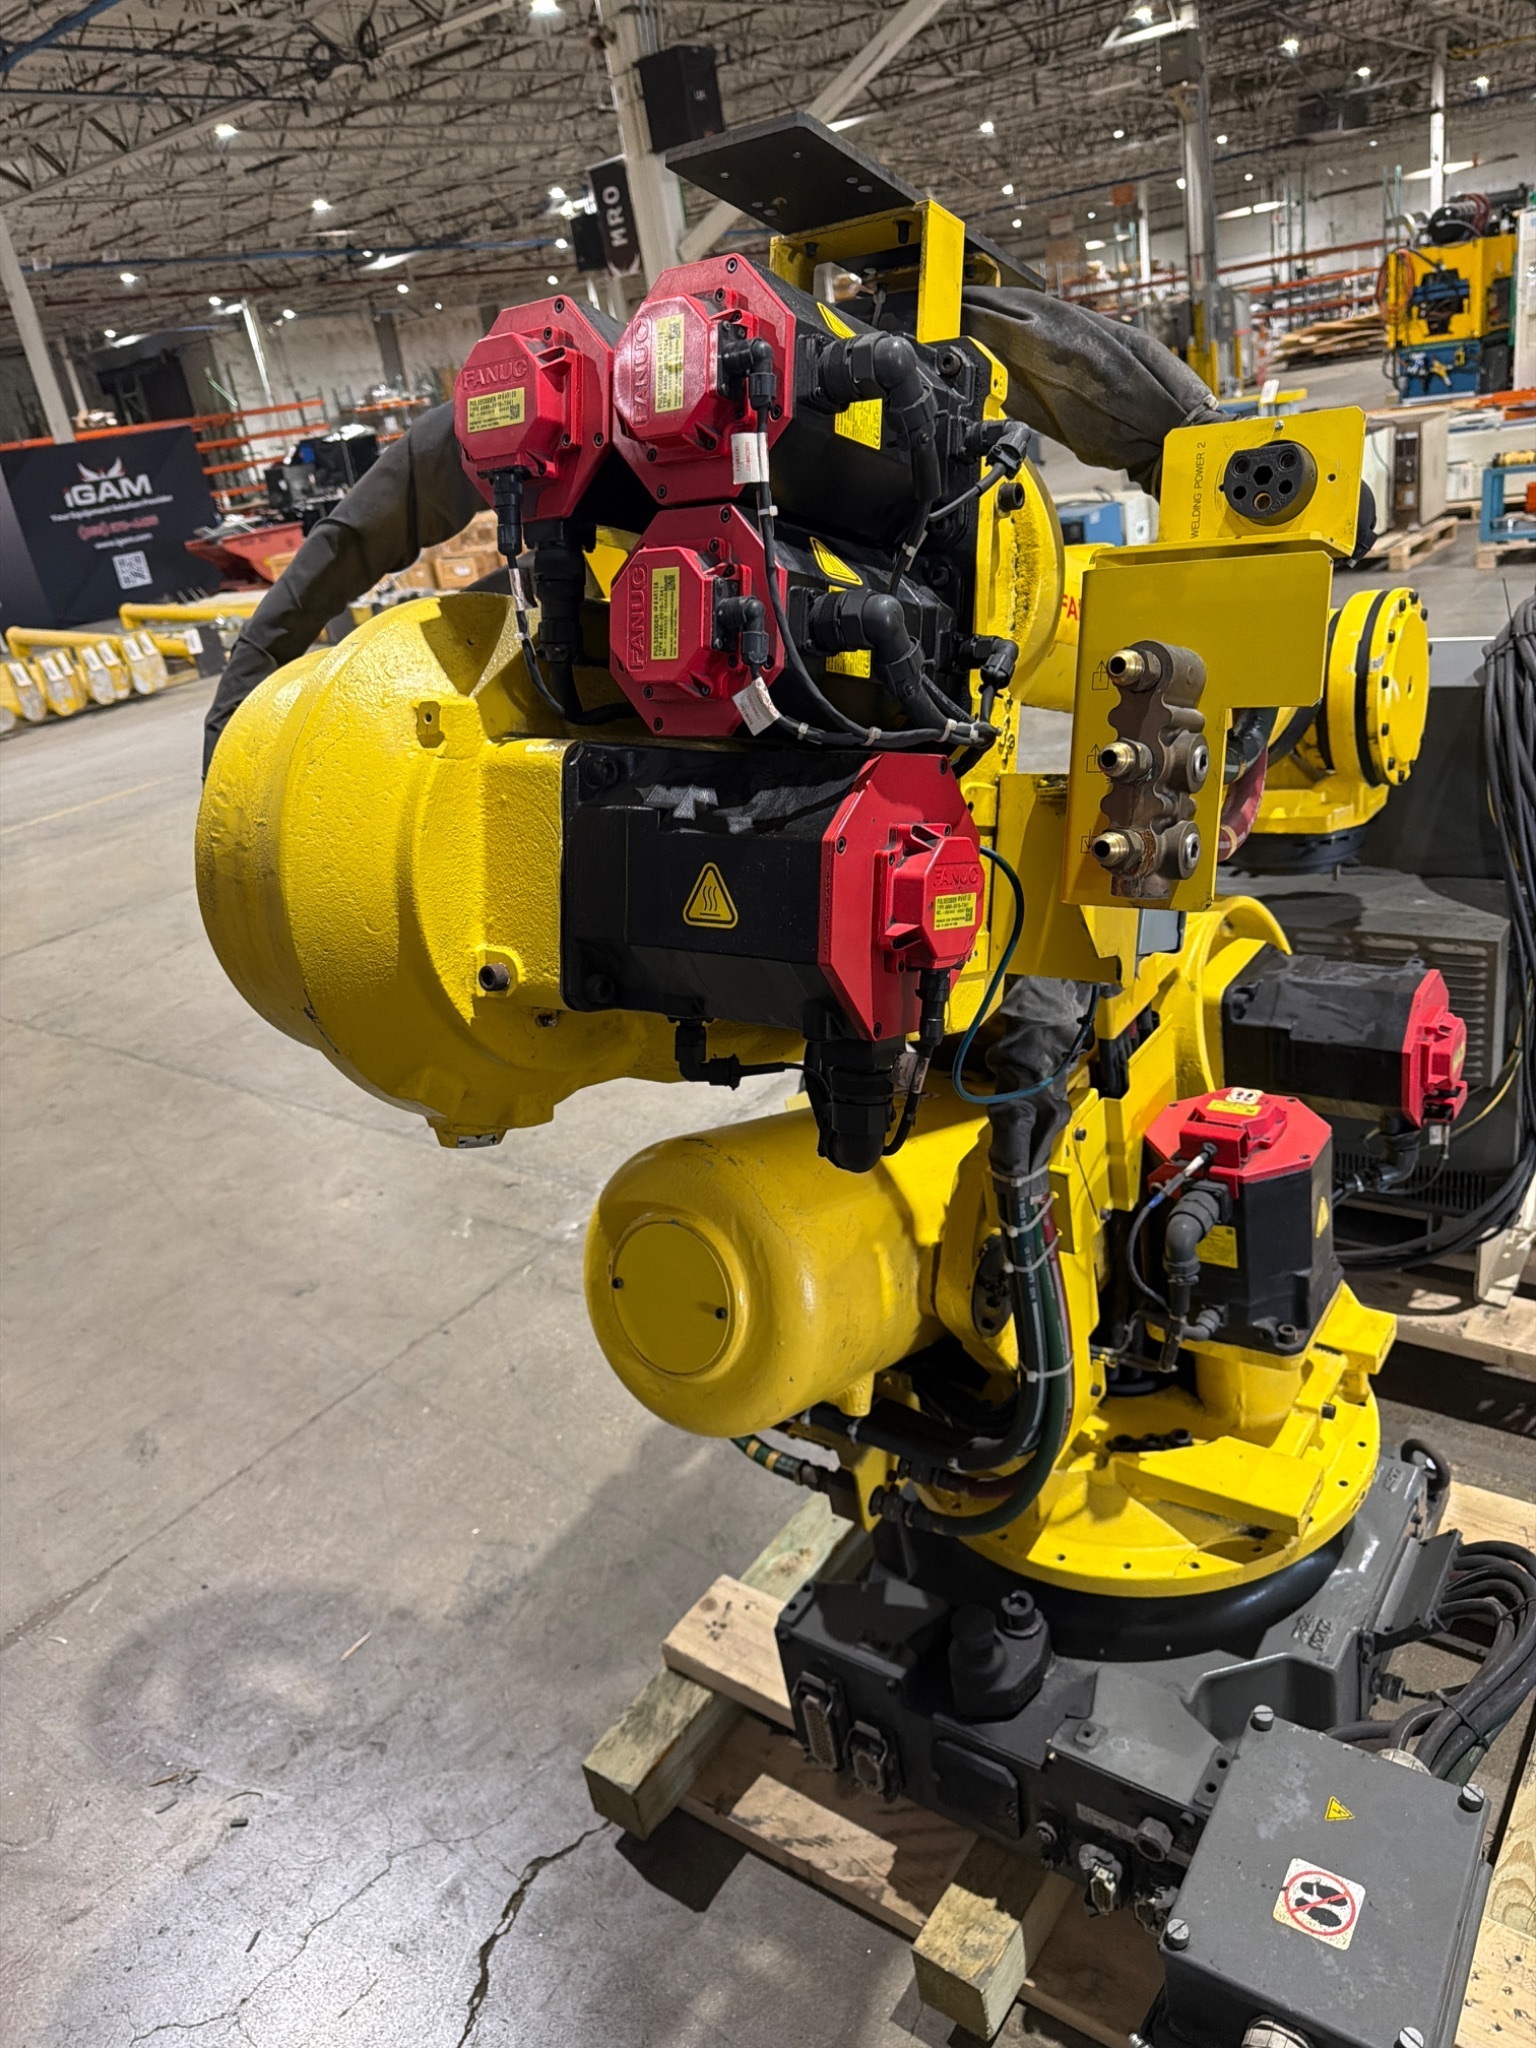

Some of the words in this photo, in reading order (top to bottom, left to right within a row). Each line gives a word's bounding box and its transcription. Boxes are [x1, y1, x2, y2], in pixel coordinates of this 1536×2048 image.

[602, 185, 629, 247] MRO
[463, 359, 527, 389] FANUC
[634, 318, 649, 424] FANUC
[1197, 441, 1206, 449] 2
[1194, 452, 1206, 489] POWER
[63, 474, 152, 508] iGAM
[1190, 493, 1203, 539] WELDING
[631, 567, 646, 670] FANUC
[934, 867, 978, 886] FANUC
